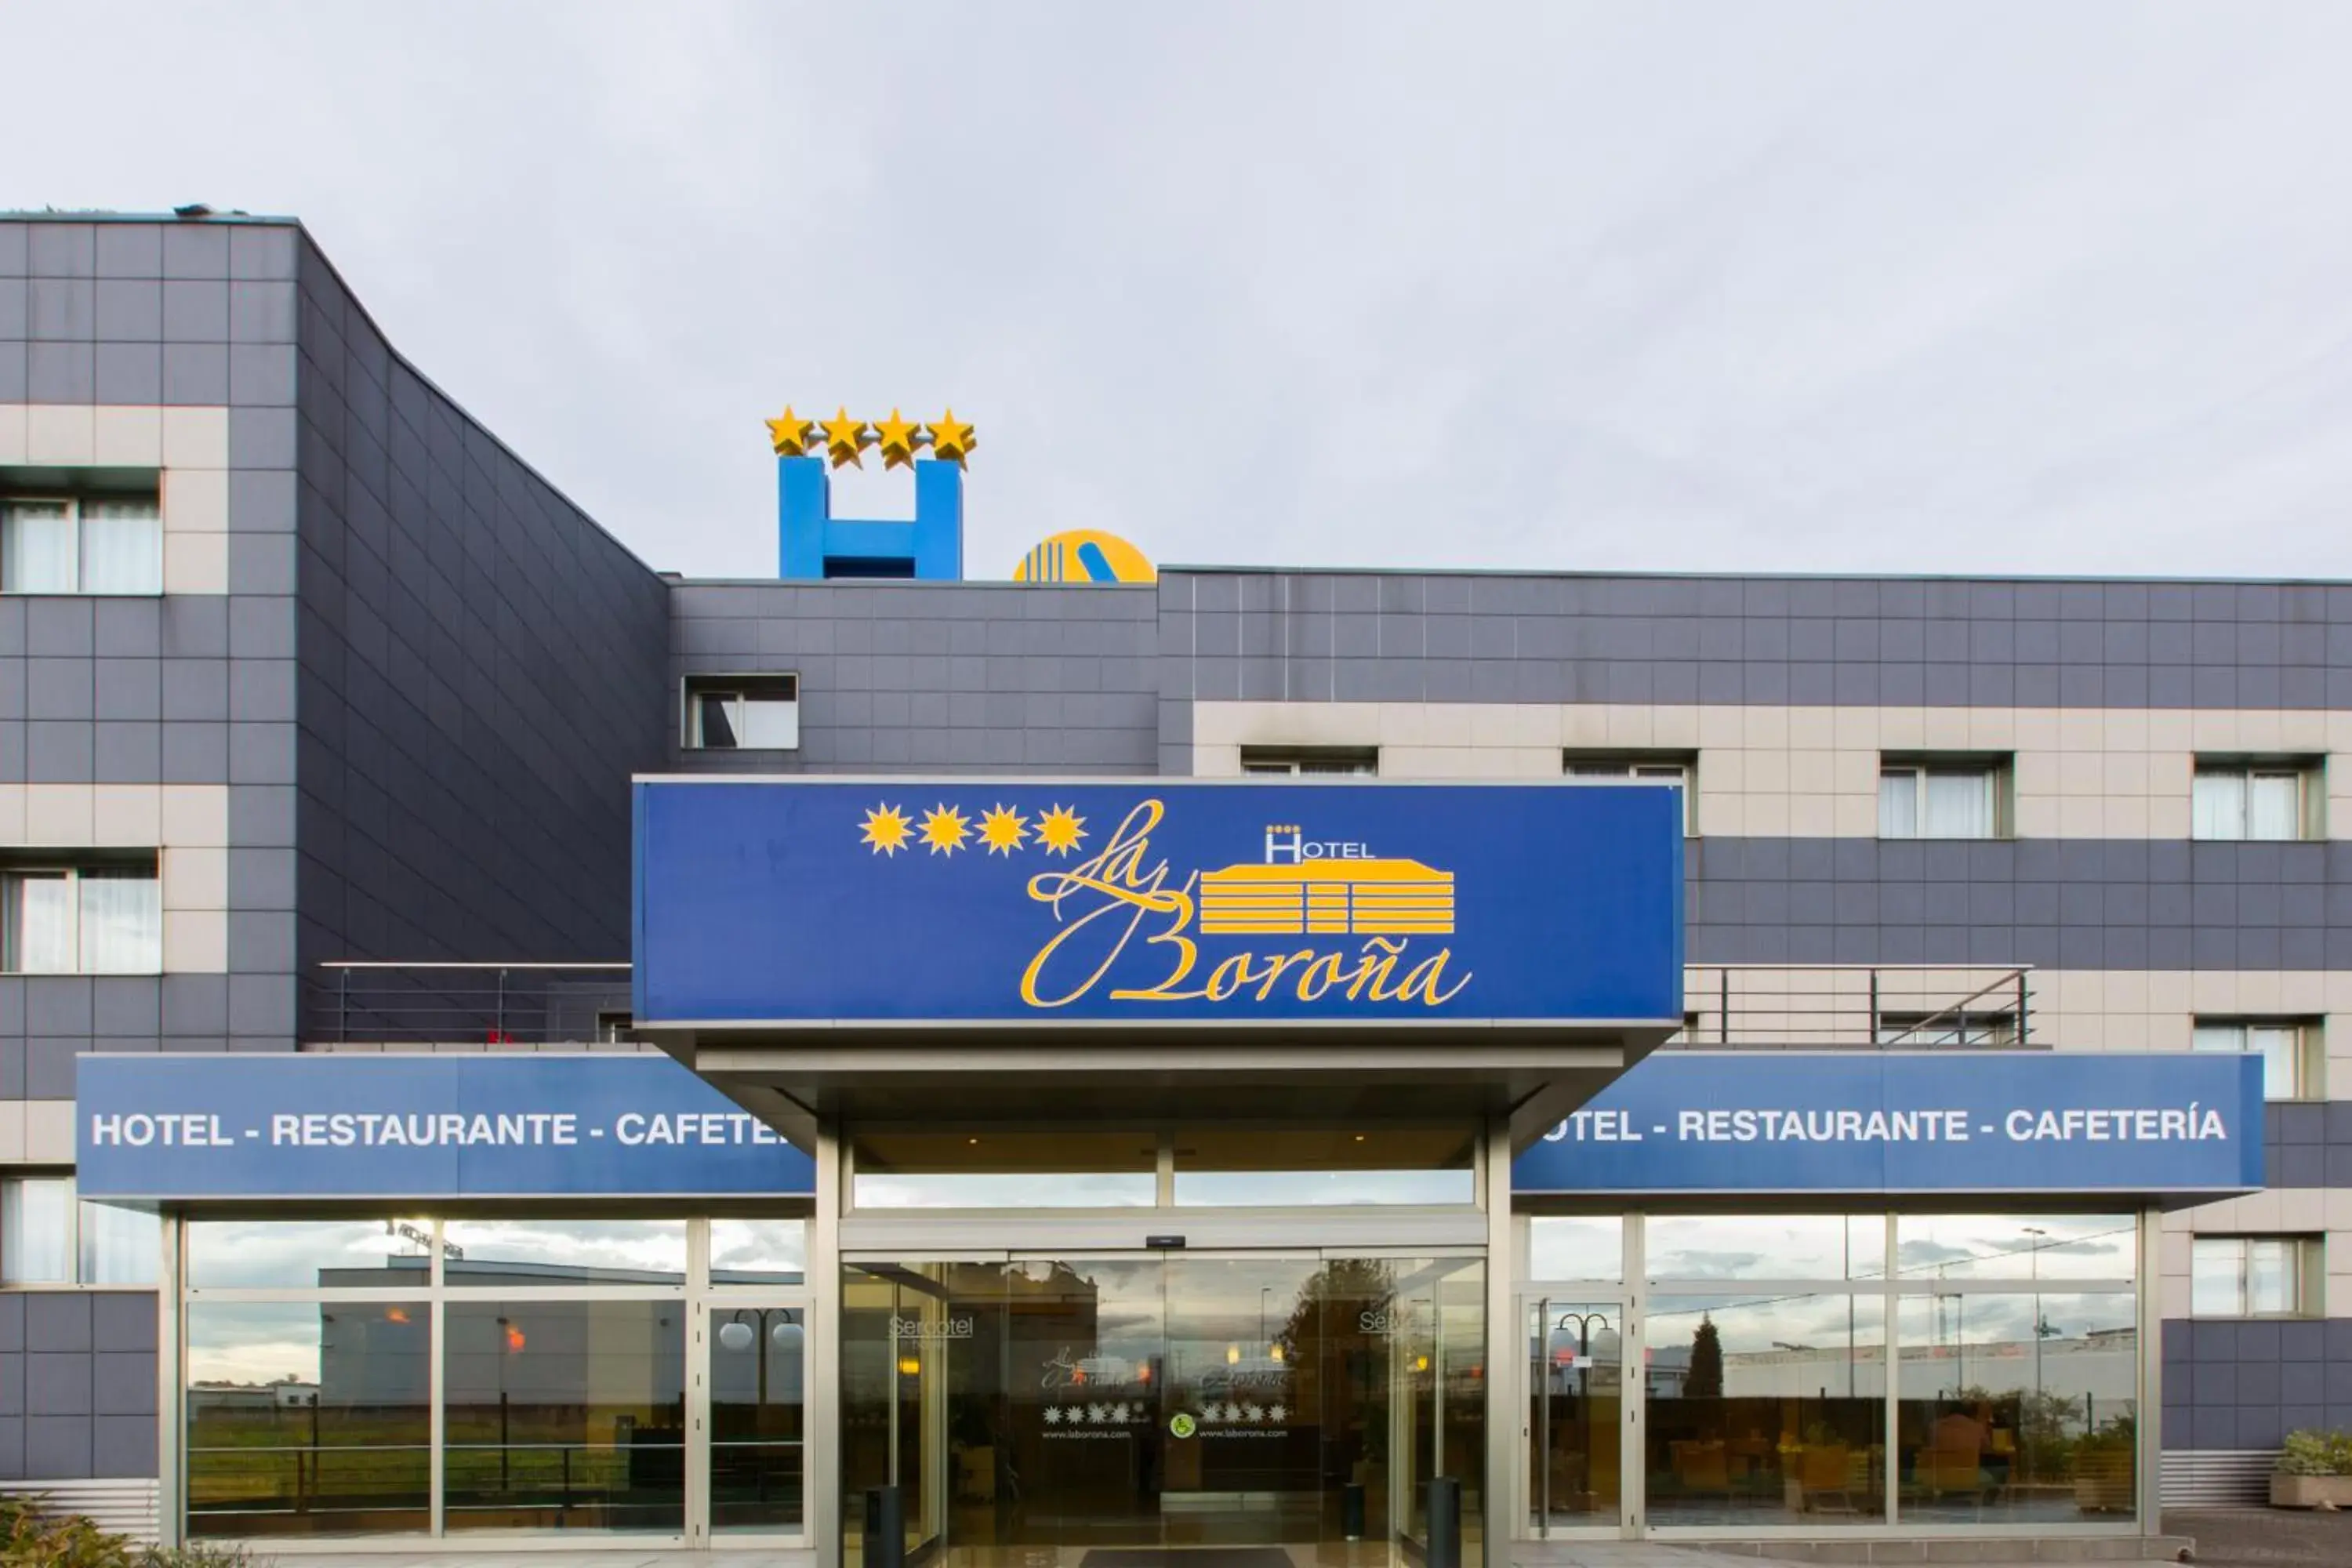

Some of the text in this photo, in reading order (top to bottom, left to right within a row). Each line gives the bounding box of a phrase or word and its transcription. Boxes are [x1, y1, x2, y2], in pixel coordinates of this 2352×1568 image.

[1265, 833, 1376, 864] HOTEL
[1021, 869, 1472, 1007] Boroña
[92, 1114, 234, 1145] HOTEL
[272, 1114, 578, 1145] RESTAURANTE
[615, 1113, 787, 1145] CAFETE
[1542, 1110, 1643, 1142] TEL
[1679, 1110, 1969, 1142] RESTAURANTE
[2005, 1102, 2227, 1141] CAFETERÍA
